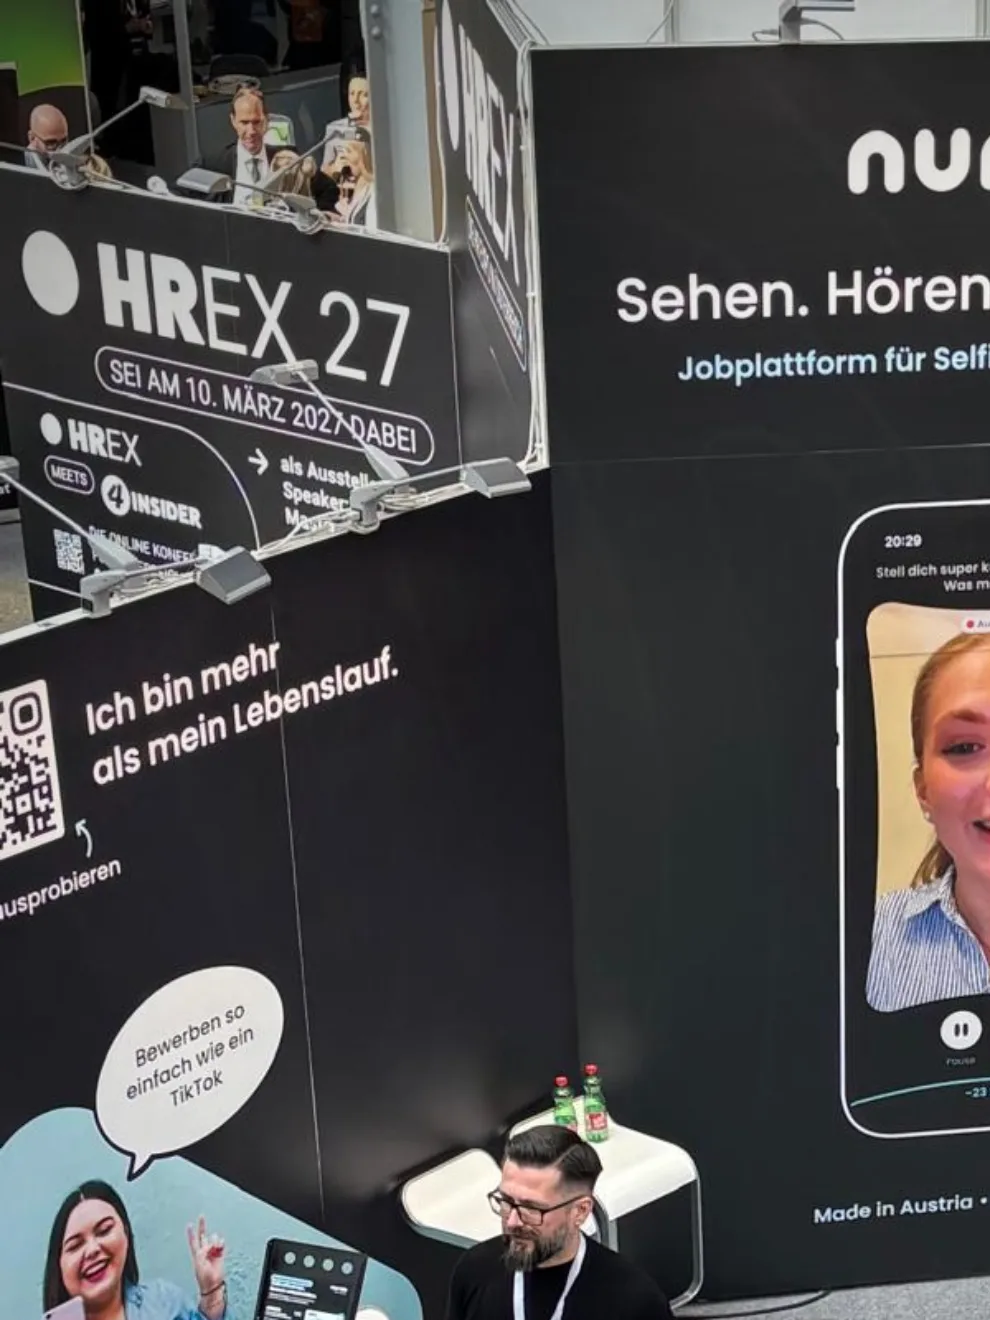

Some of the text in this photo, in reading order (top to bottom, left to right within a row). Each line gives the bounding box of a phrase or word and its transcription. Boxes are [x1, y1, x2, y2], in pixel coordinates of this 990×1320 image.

[97, 242, 411, 388] HREX 27
[615, 273, 809, 323] Sehen.
[678, 346, 877, 386] Jobplattform
[885, 344, 926, 374] für
[109, 358, 416, 453] SEI AM 10. MÄRZ 2027 DABEI
[67, 418, 142, 467] HREX
[50, 463, 88, 488] MEETS
[280, 455, 374, 488] als Ausstell
[884, 534, 923, 549] 20:29
[876, 564, 905, 579] Stell
[908, 561, 937, 578] dich
[940, 560, 979, 578] super
[943, 576, 973, 592] Was
[86, 641, 281, 736] Ich bin mehr
[93, 645, 399, 786] als mein Lebenslauf.
[135, 1004, 246, 1068] Bewerben so
[126, 1026, 255, 1101] einfach wie ein
[169, 1071, 224, 1107] TikTok
[814, 1201, 871, 1224] Made
[877, 1198, 896, 1217] in
[900, 1194, 973, 1215] Austria
